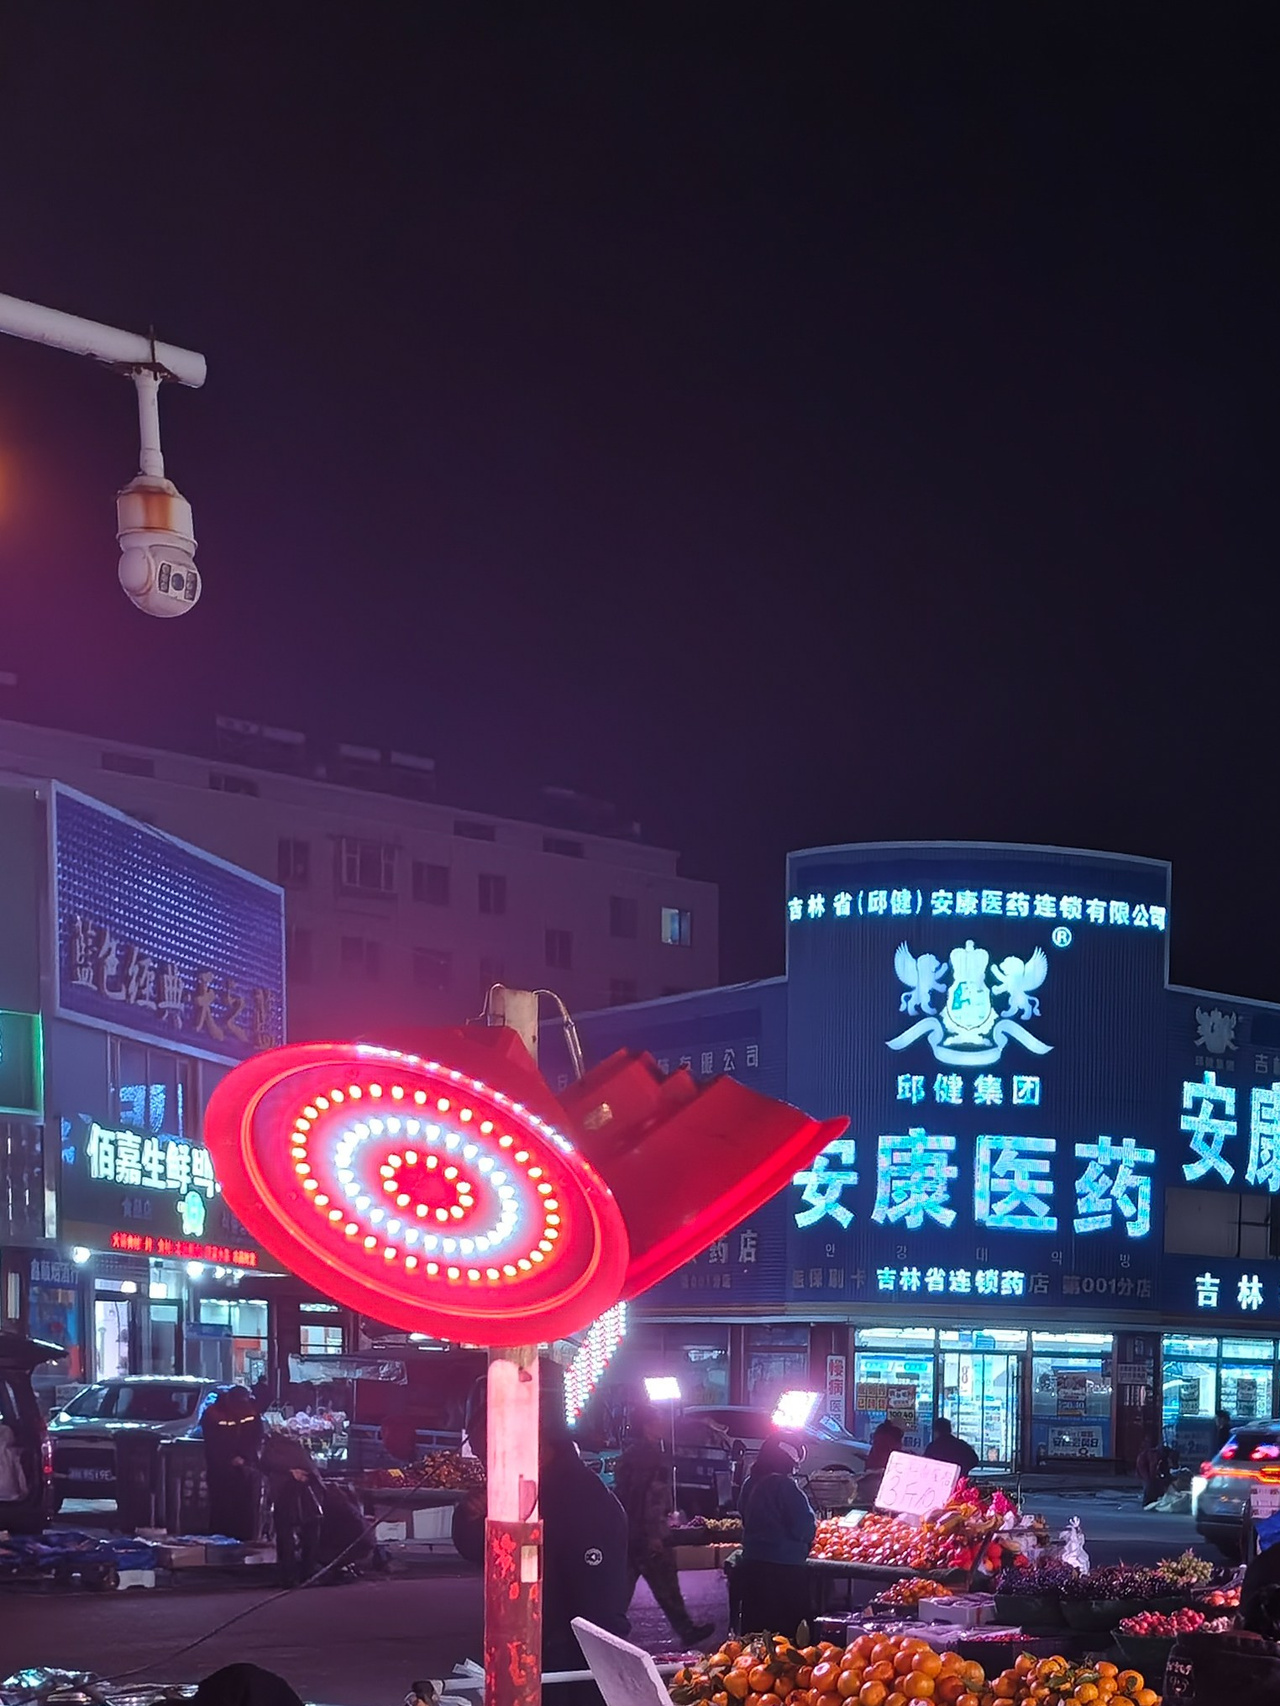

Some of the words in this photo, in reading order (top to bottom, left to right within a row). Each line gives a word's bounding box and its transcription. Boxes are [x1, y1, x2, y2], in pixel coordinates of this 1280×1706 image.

[788, 889, 1168, 931] 吉林省(邱健)安康医药连锁有限公司
[896, 1073, 1041, 1106] 邱健集团
[793, 1127, 1156, 1238] 安康医药
